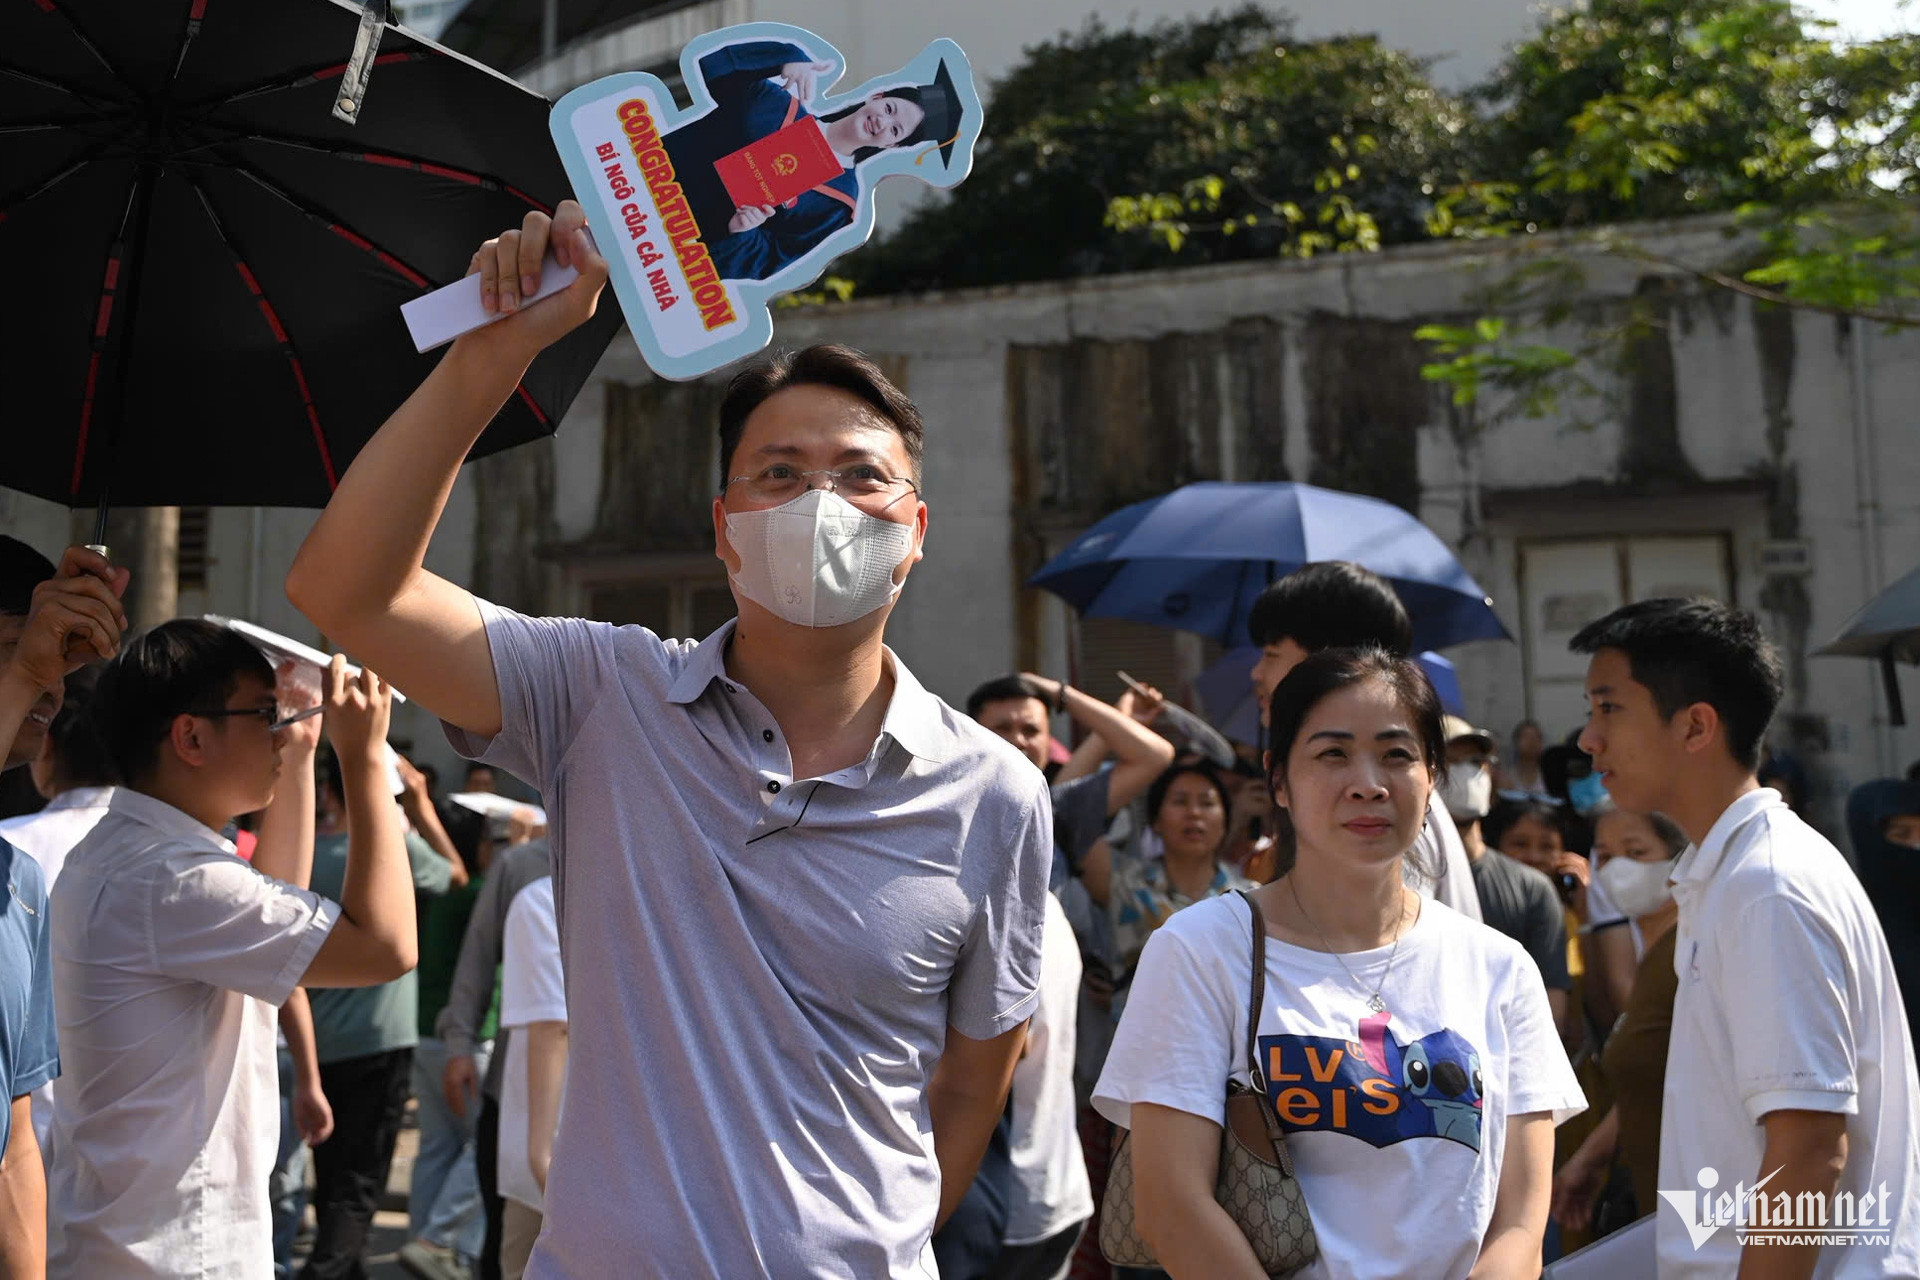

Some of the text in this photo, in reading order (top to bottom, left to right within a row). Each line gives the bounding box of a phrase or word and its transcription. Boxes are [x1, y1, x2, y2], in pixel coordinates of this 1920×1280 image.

[596, 141, 680, 312] BÍ NGÔ CỦA CẢ NHÀ
[617, 99, 737, 332] CONGRATULATION
